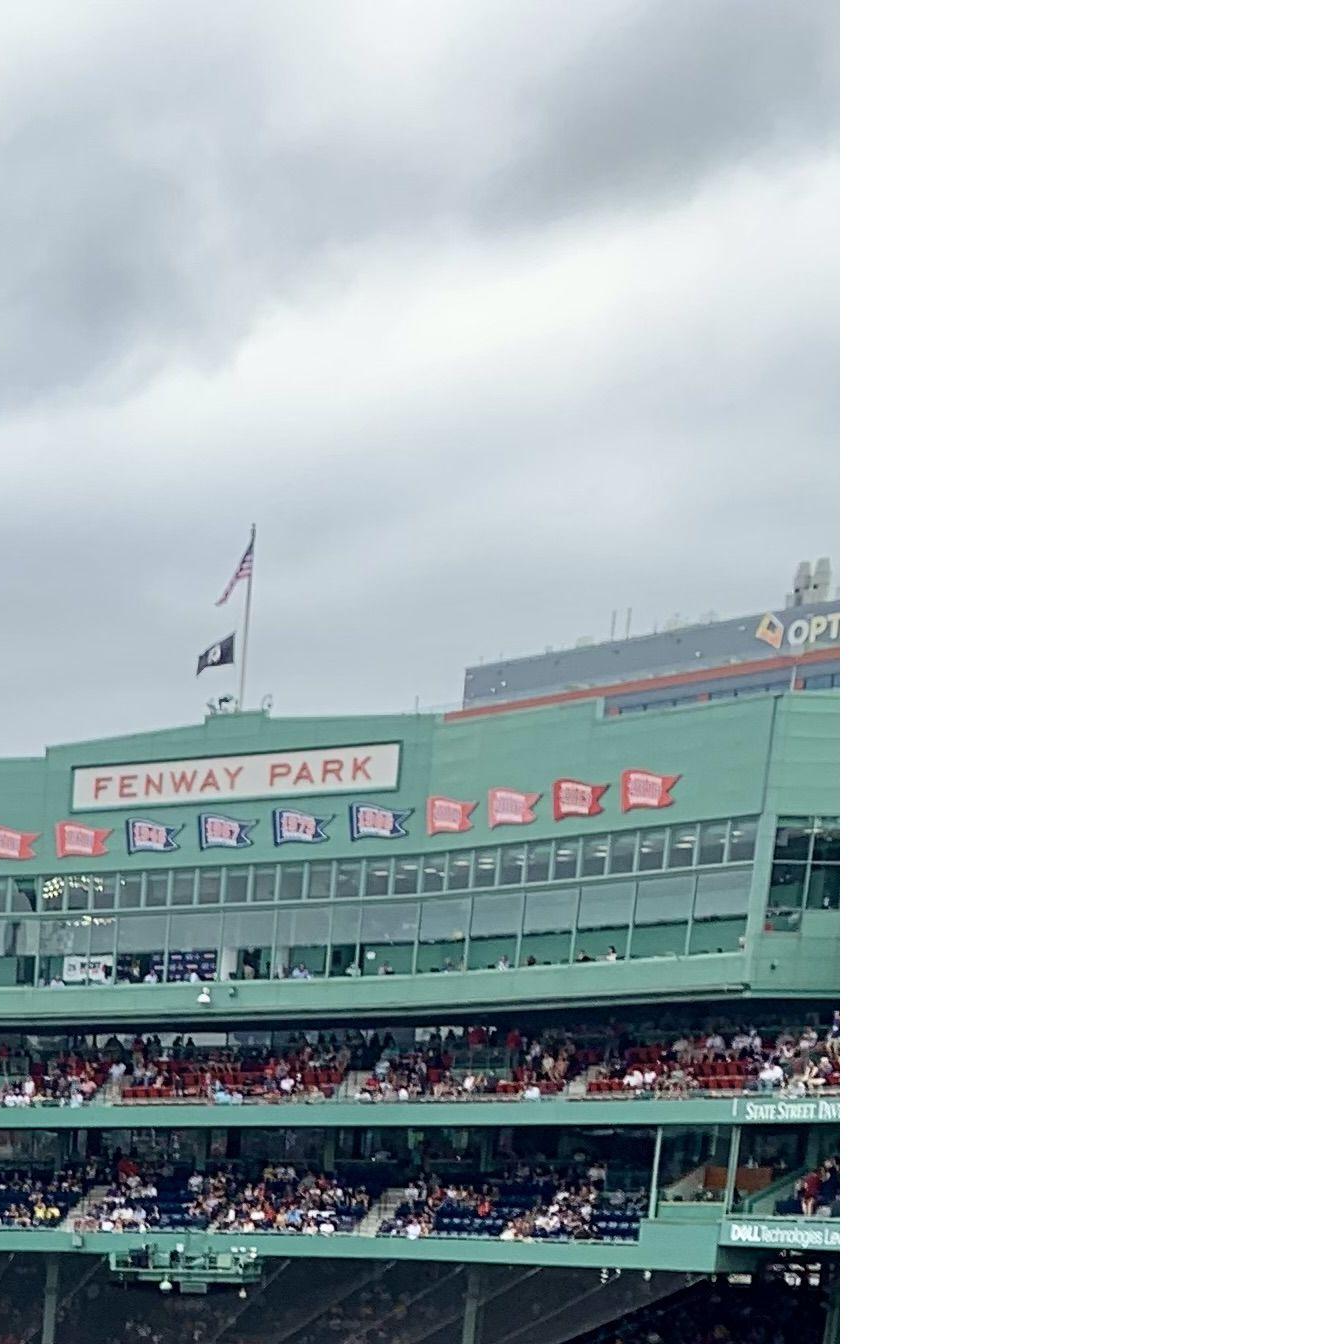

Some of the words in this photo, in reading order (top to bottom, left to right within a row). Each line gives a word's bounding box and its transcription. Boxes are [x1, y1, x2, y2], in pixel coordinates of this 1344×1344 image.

[93, 766, 244, 799] FENWAY
[270, 756, 373, 787] PARK
[746, 1102, 776, 1120] STATE
[778, 1101, 816, 1120] STREET
